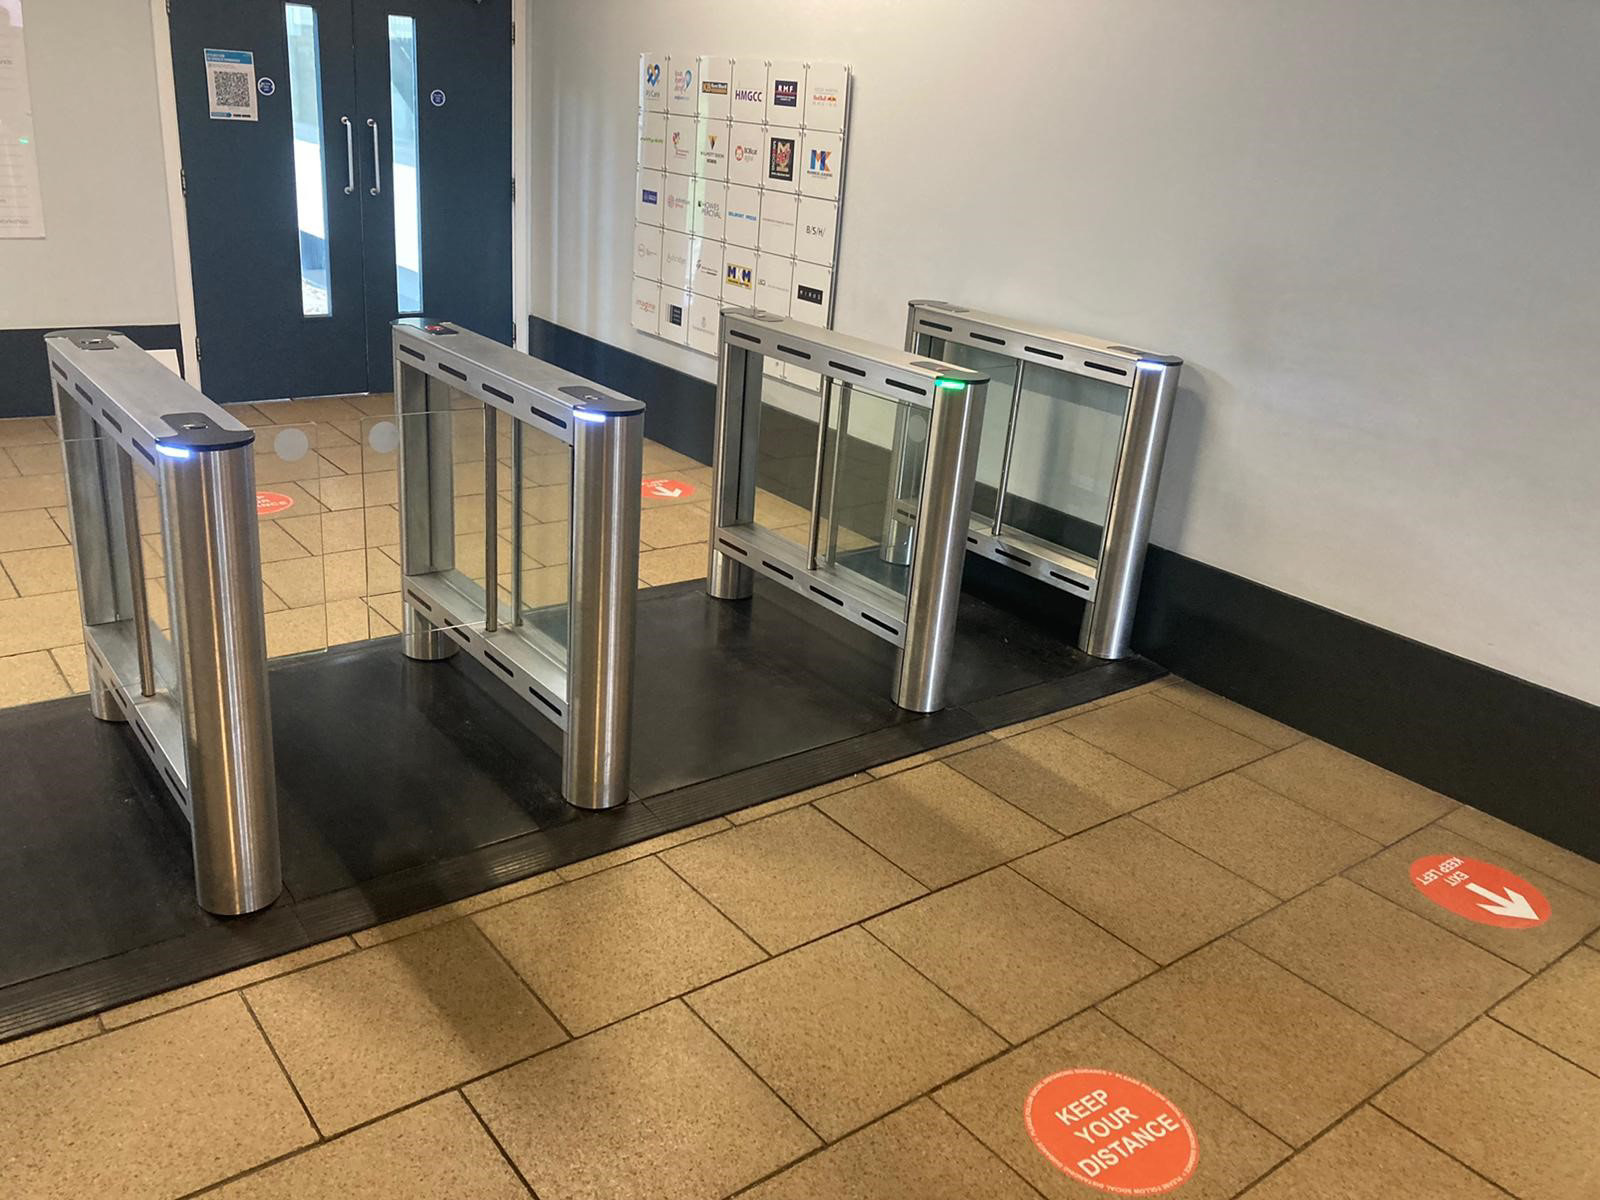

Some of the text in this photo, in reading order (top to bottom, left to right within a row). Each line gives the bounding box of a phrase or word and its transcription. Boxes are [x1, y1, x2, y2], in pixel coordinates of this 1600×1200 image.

[735, 90, 762, 102] HMGCC
[778, 84, 793, 92] RMF
[810, 149, 832, 171] MK
[727, 265, 751, 283] MKM
[1416, 856, 1465, 886] KEEP LEFT
[1443, 871, 1469, 887] EXIT
[1055, 1089, 1109, 1126] KEEP
[1074, 1106, 1139, 1144] YOUR
[1077, 1113, 1180, 1177] DISTANCE
